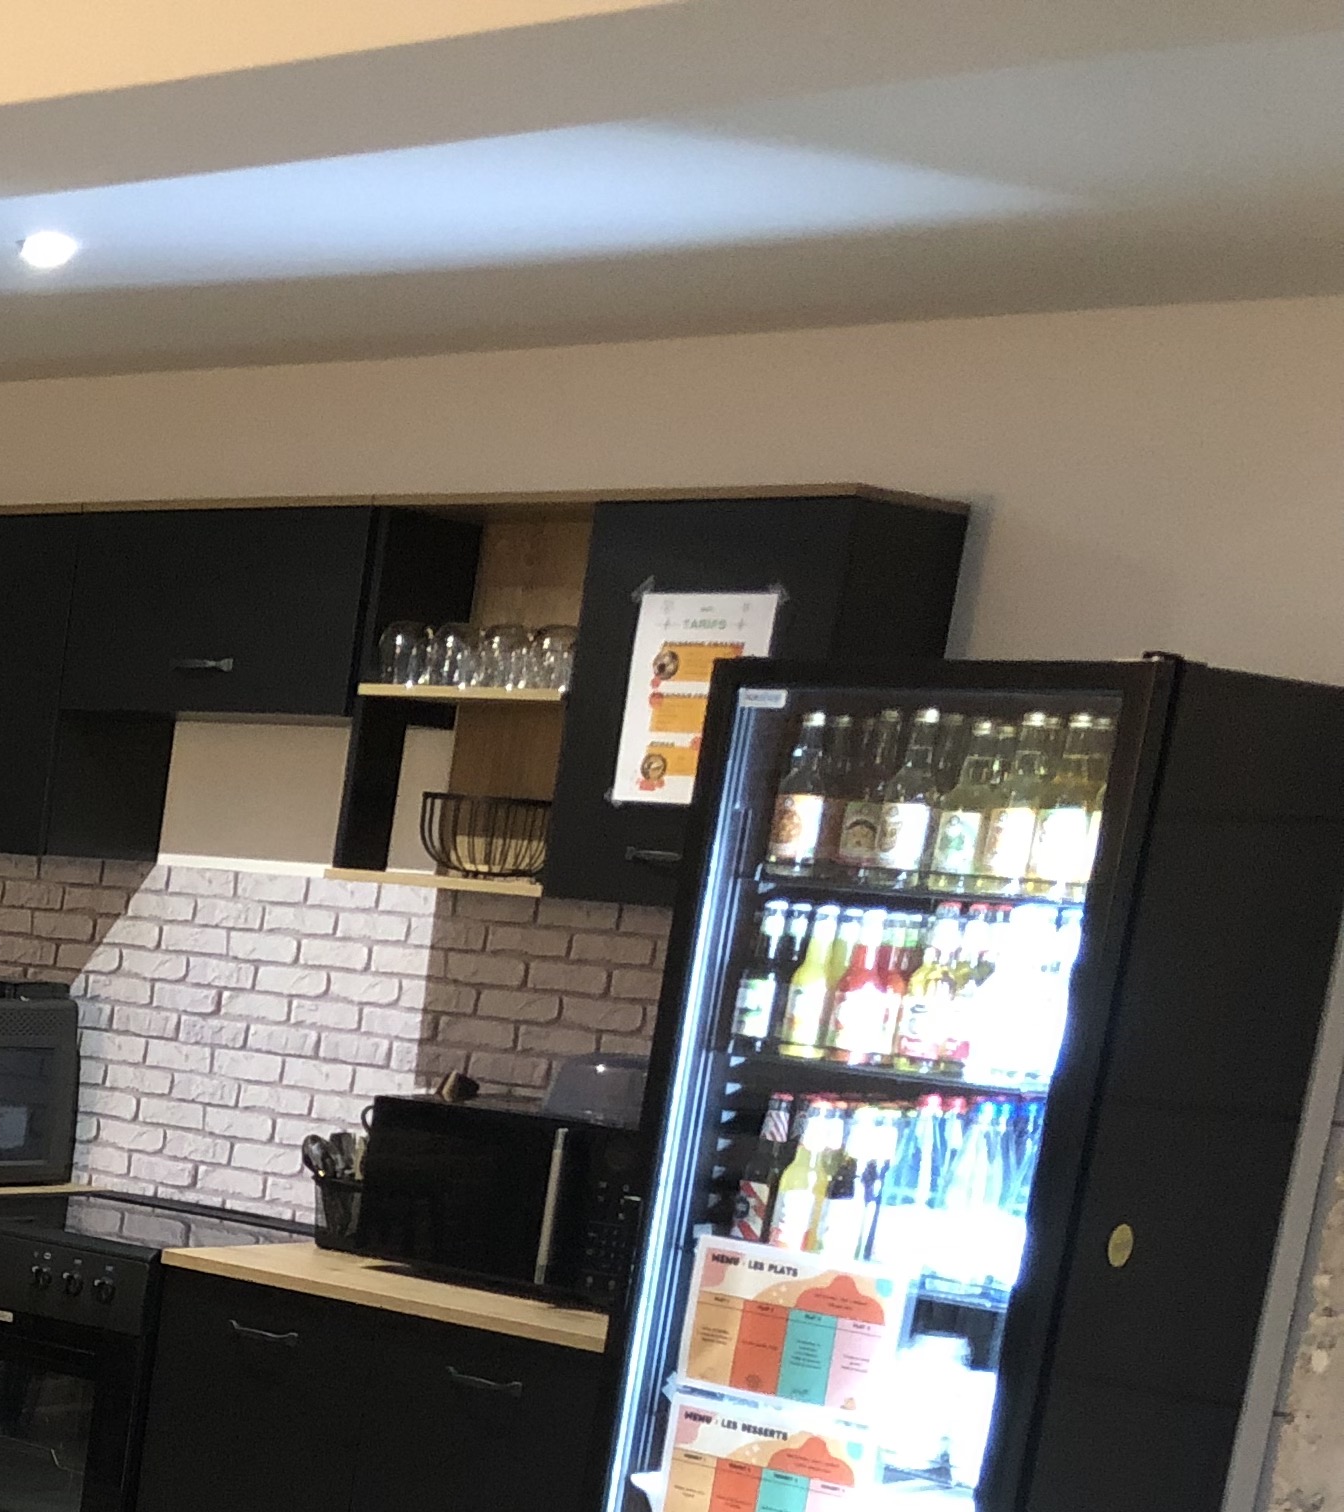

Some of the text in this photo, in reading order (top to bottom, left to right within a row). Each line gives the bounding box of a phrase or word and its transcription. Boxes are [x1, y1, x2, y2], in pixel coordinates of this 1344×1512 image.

[712, 1253, 740, 1266] MENU
[768, 1263, 798, 1278] PLATS
[684, 1411, 788, 1442] MENU LES DESSERTS
